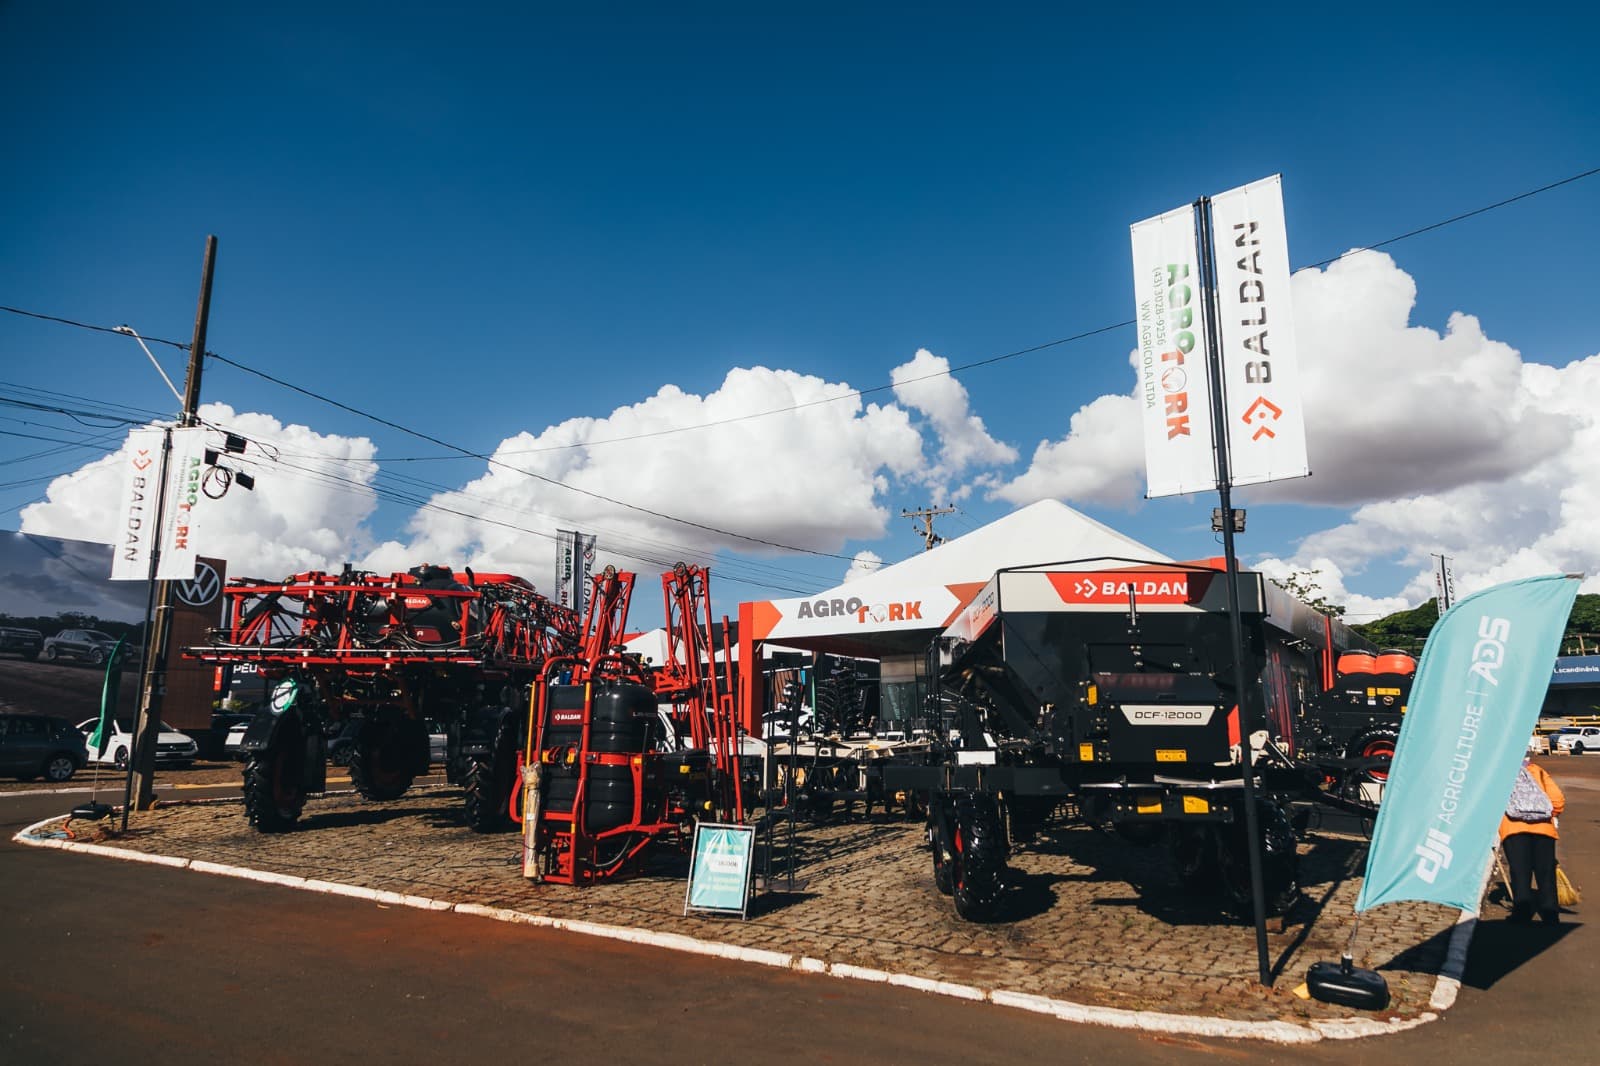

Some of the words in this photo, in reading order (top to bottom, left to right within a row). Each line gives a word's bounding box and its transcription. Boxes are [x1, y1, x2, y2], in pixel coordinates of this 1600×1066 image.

[1140, 301, 1151, 323] WW
[1234, 221, 1272, 384] BALDAN
[1145, 381, 1156, 409] LTDA
[124, 477, 146, 562] BALDAN
[1102, 582, 1188, 596] BALDAN
[1134, 711, 1202, 719] DCF-12000
[1438, 703, 1484, 824] AGRICULTURE
